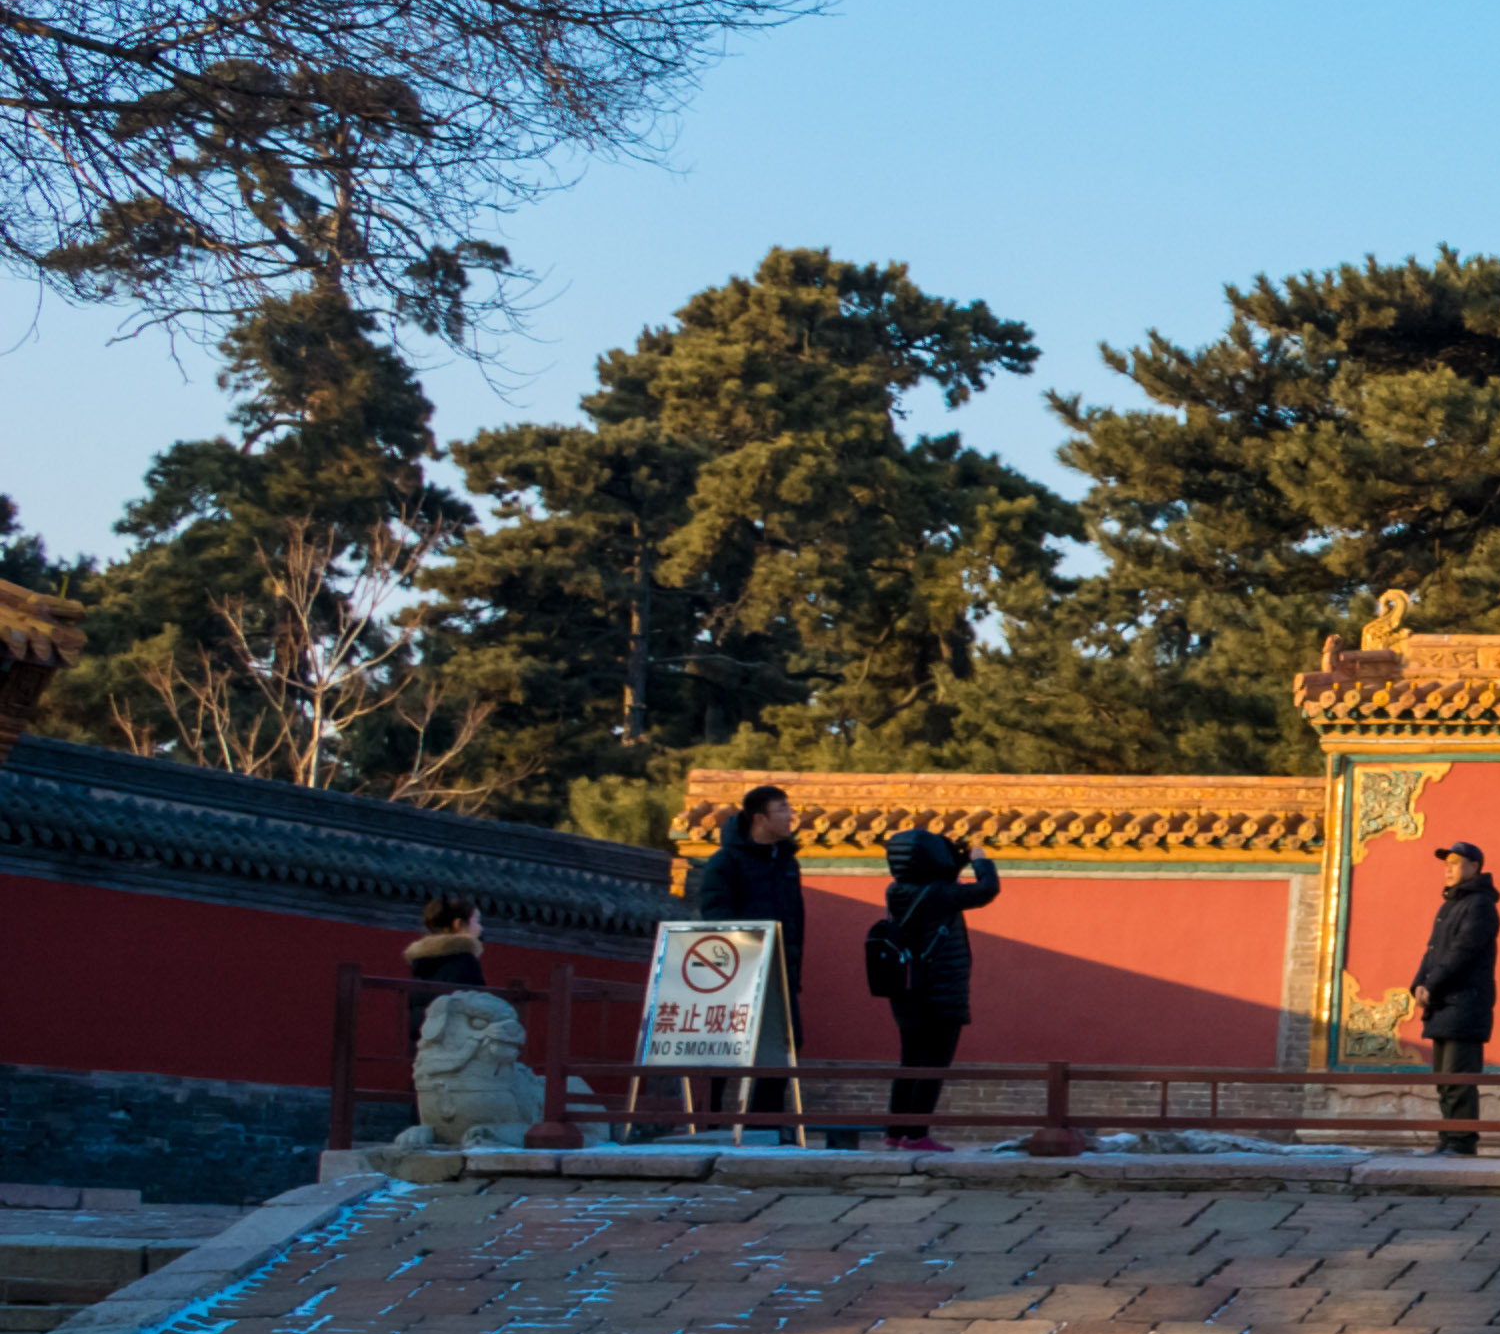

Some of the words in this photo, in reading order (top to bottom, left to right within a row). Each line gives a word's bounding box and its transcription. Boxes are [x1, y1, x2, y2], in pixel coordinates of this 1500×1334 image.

[654, 1001, 750, 1034] 禁止吸烟
[650, 1040, 671, 1056] NO
[674, 1040, 743, 1056] SMOKING
